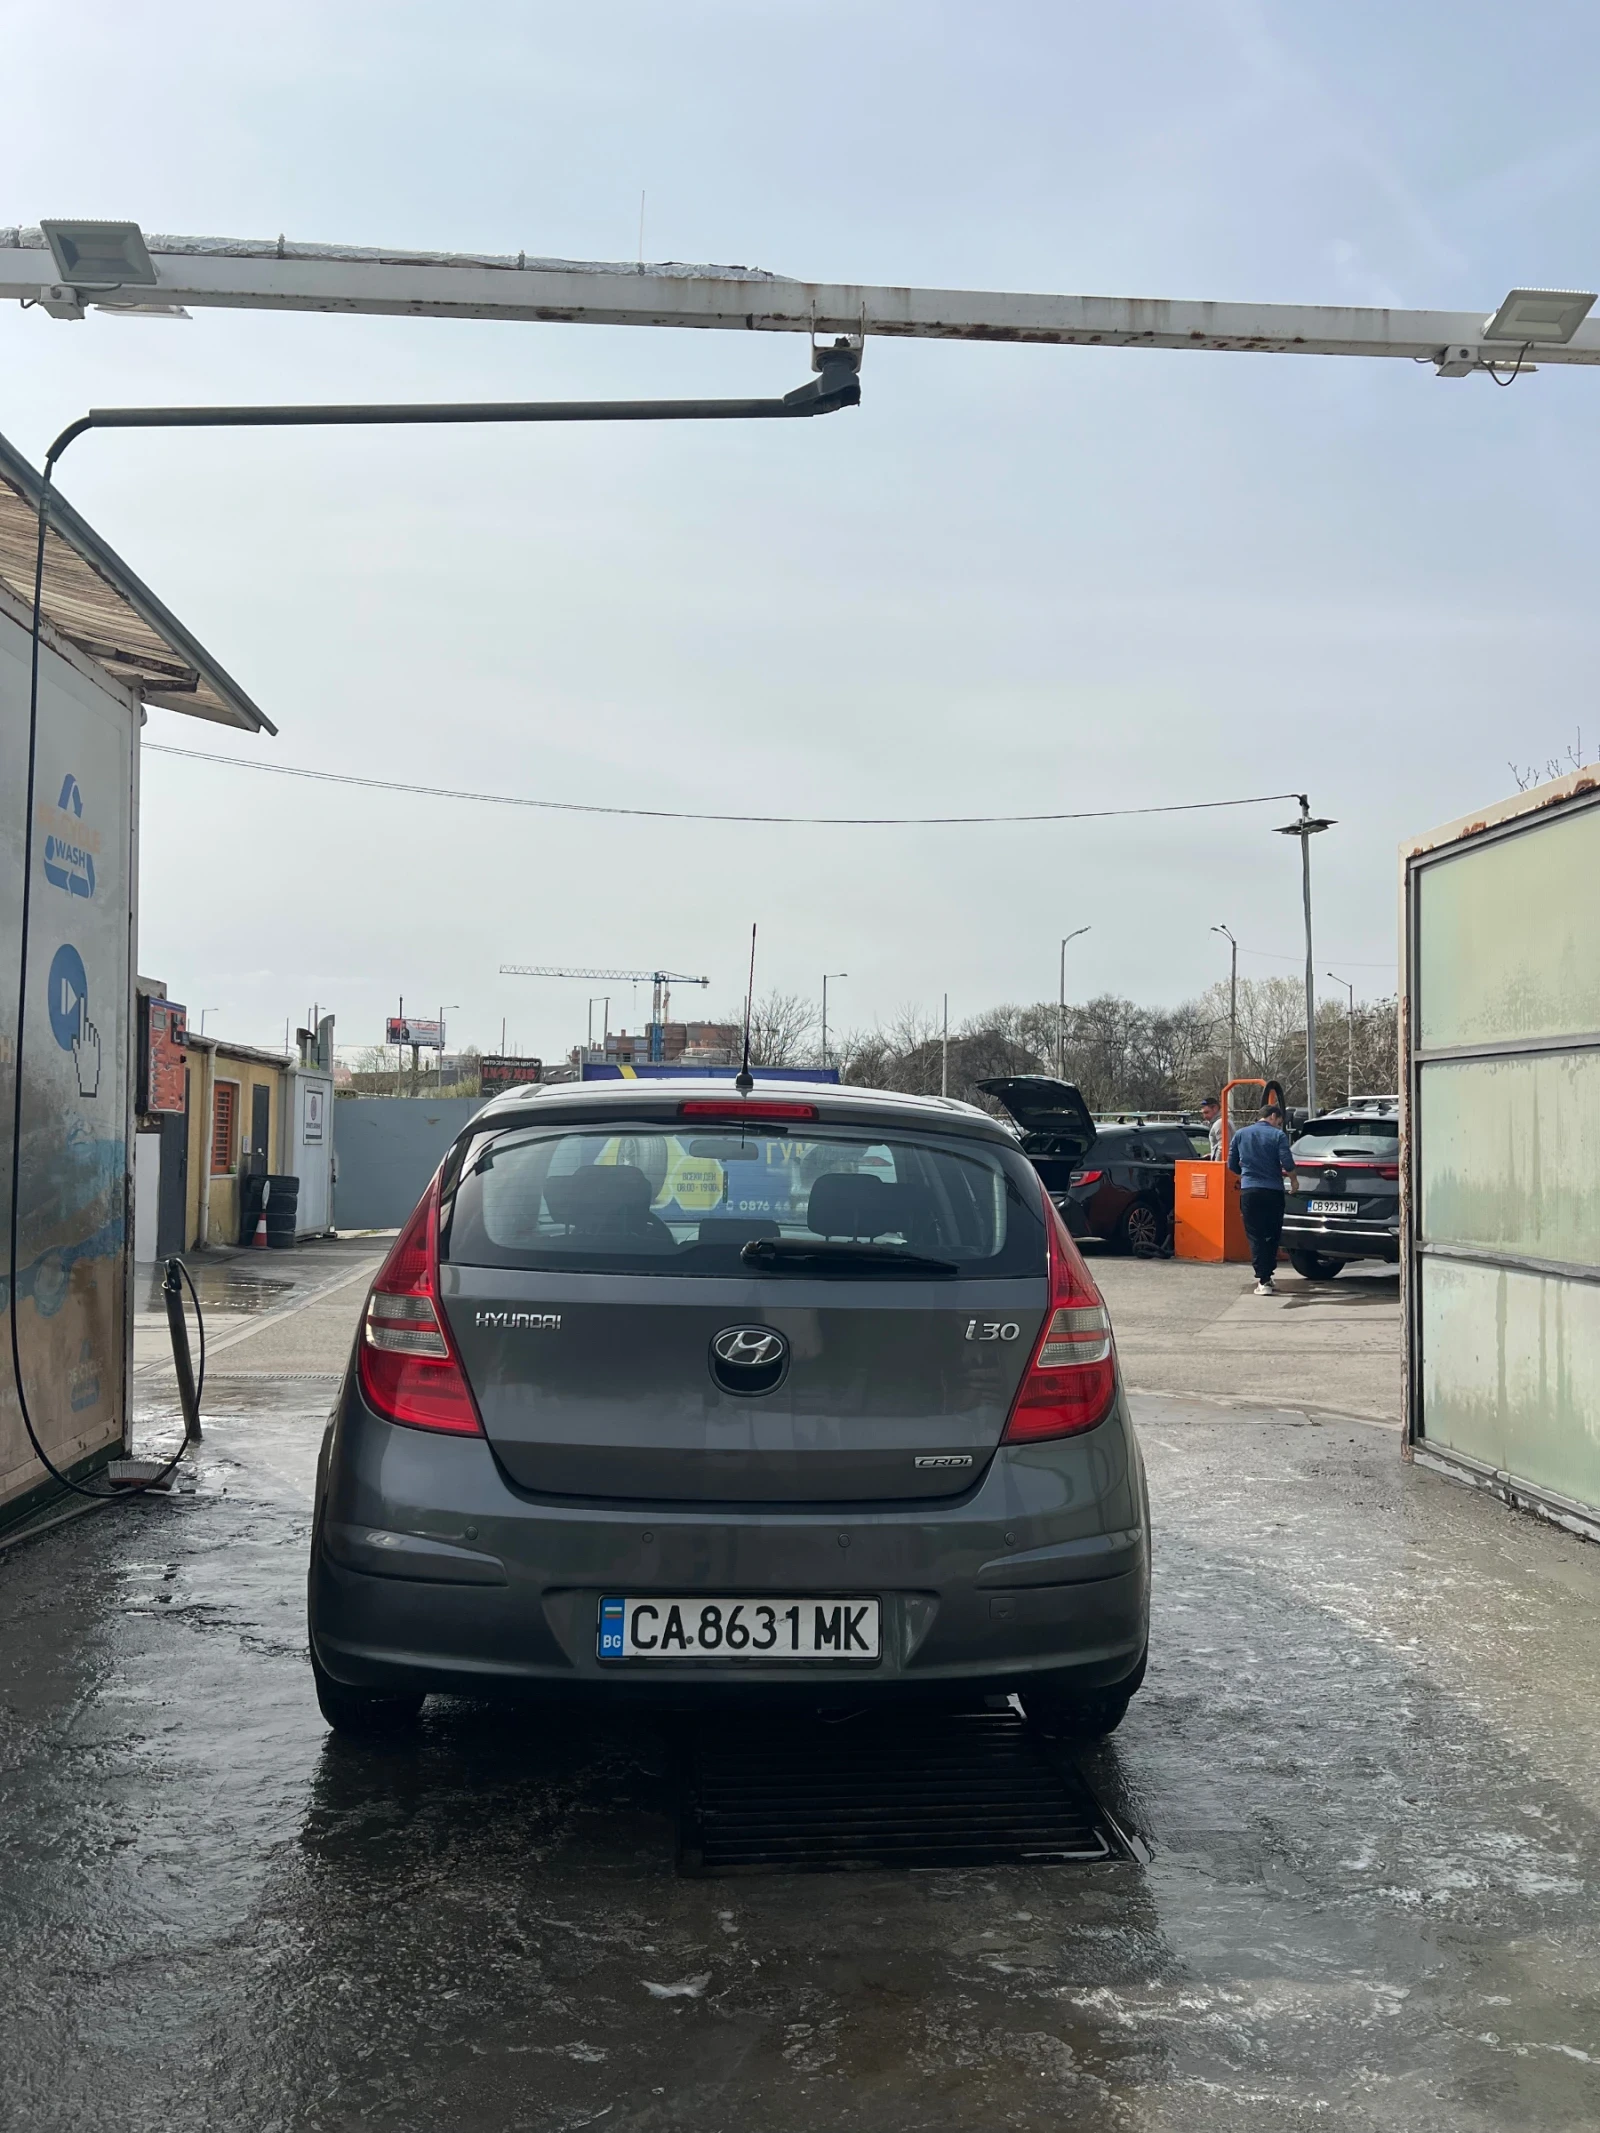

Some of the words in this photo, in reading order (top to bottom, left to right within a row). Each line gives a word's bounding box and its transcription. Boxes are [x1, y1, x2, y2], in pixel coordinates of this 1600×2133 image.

[55, 837, 86, 869] WASH
[739, 1200, 770, 1211] 0876
[1312, 1201, 1323, 1212] CB
[1324, 1202, 1343, 1212] 9231
[1345, 1203, 1357, 1213] HM
[475, 1312, 561, 1330] HYUNDAI
[630, 1604, 688, 1650] CA
[698, 1605, 800, 1651] 8631
[814, 1606, 870, 1651] MK
[602, 1634, 622, 1649] BG
